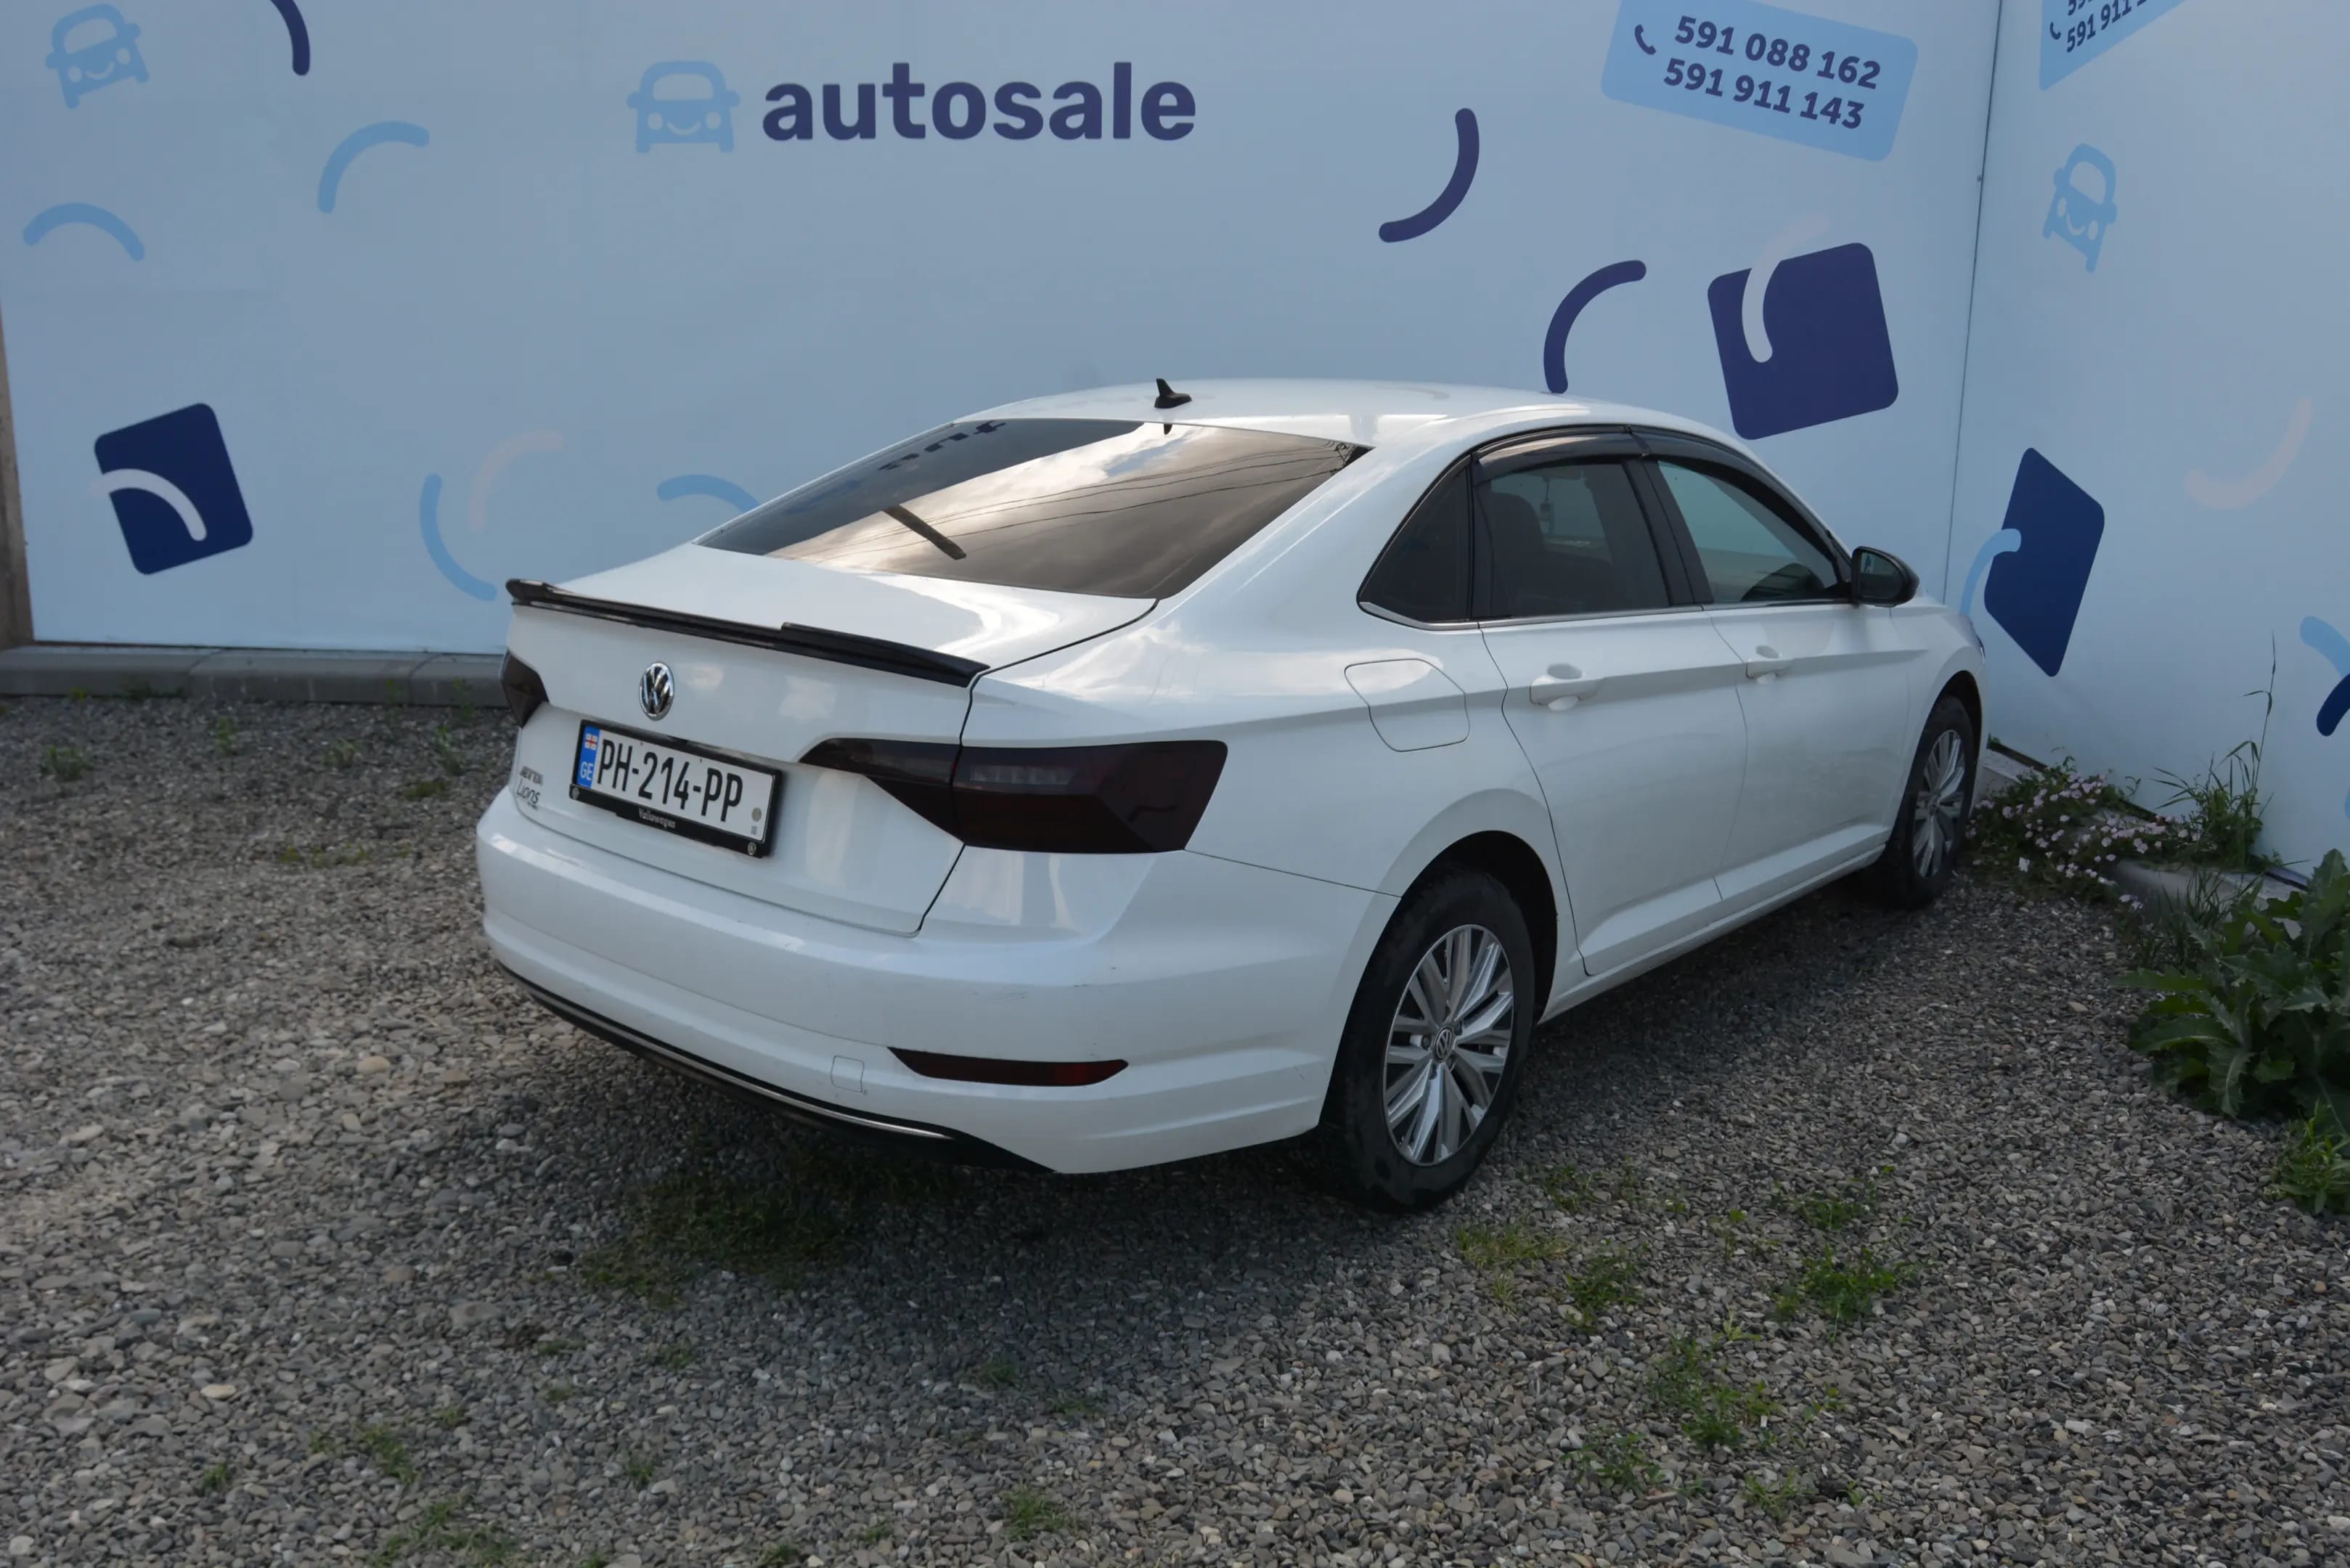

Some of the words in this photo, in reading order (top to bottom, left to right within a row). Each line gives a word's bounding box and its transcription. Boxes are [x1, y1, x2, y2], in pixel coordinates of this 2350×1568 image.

[1675, 15, 1734, 55] 591
[1745, 33, 1811, 72] 088
[1816, 51, 1880, 90] 162
[2066, 14, 2096, 53] 591
[762, 62, 1196, 142] autosale
[1663, 57, 1723, 97] 591
[1733, 75, 1791, 114] 911
[1800, 91, 1865, 129] 143
[581, 761, 594, 781] GE
[597, 738, 743, 822] PH-214-PP
